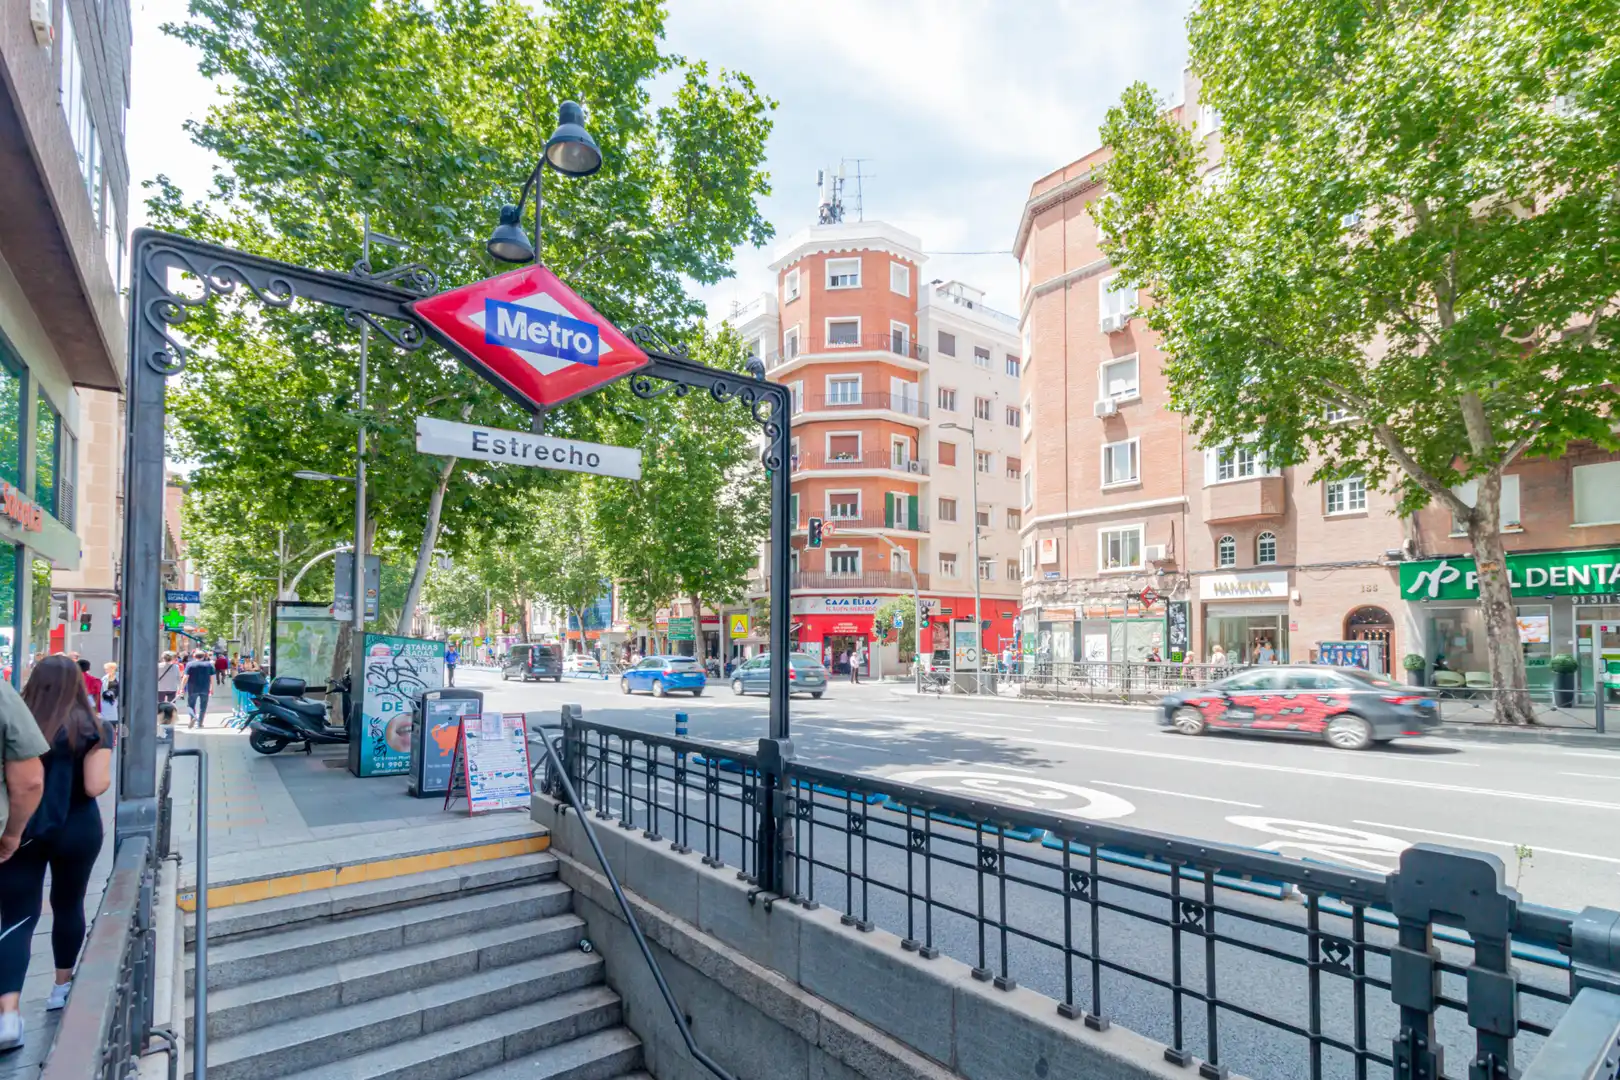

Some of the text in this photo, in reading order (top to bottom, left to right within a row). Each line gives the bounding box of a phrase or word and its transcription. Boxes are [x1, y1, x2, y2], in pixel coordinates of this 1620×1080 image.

[496, 307, 593, 355] Metro
[472, 430, 600, 468] Estrecho
[825, 598, 850, 606] CASA
[381, 701, 403, 712] DE
